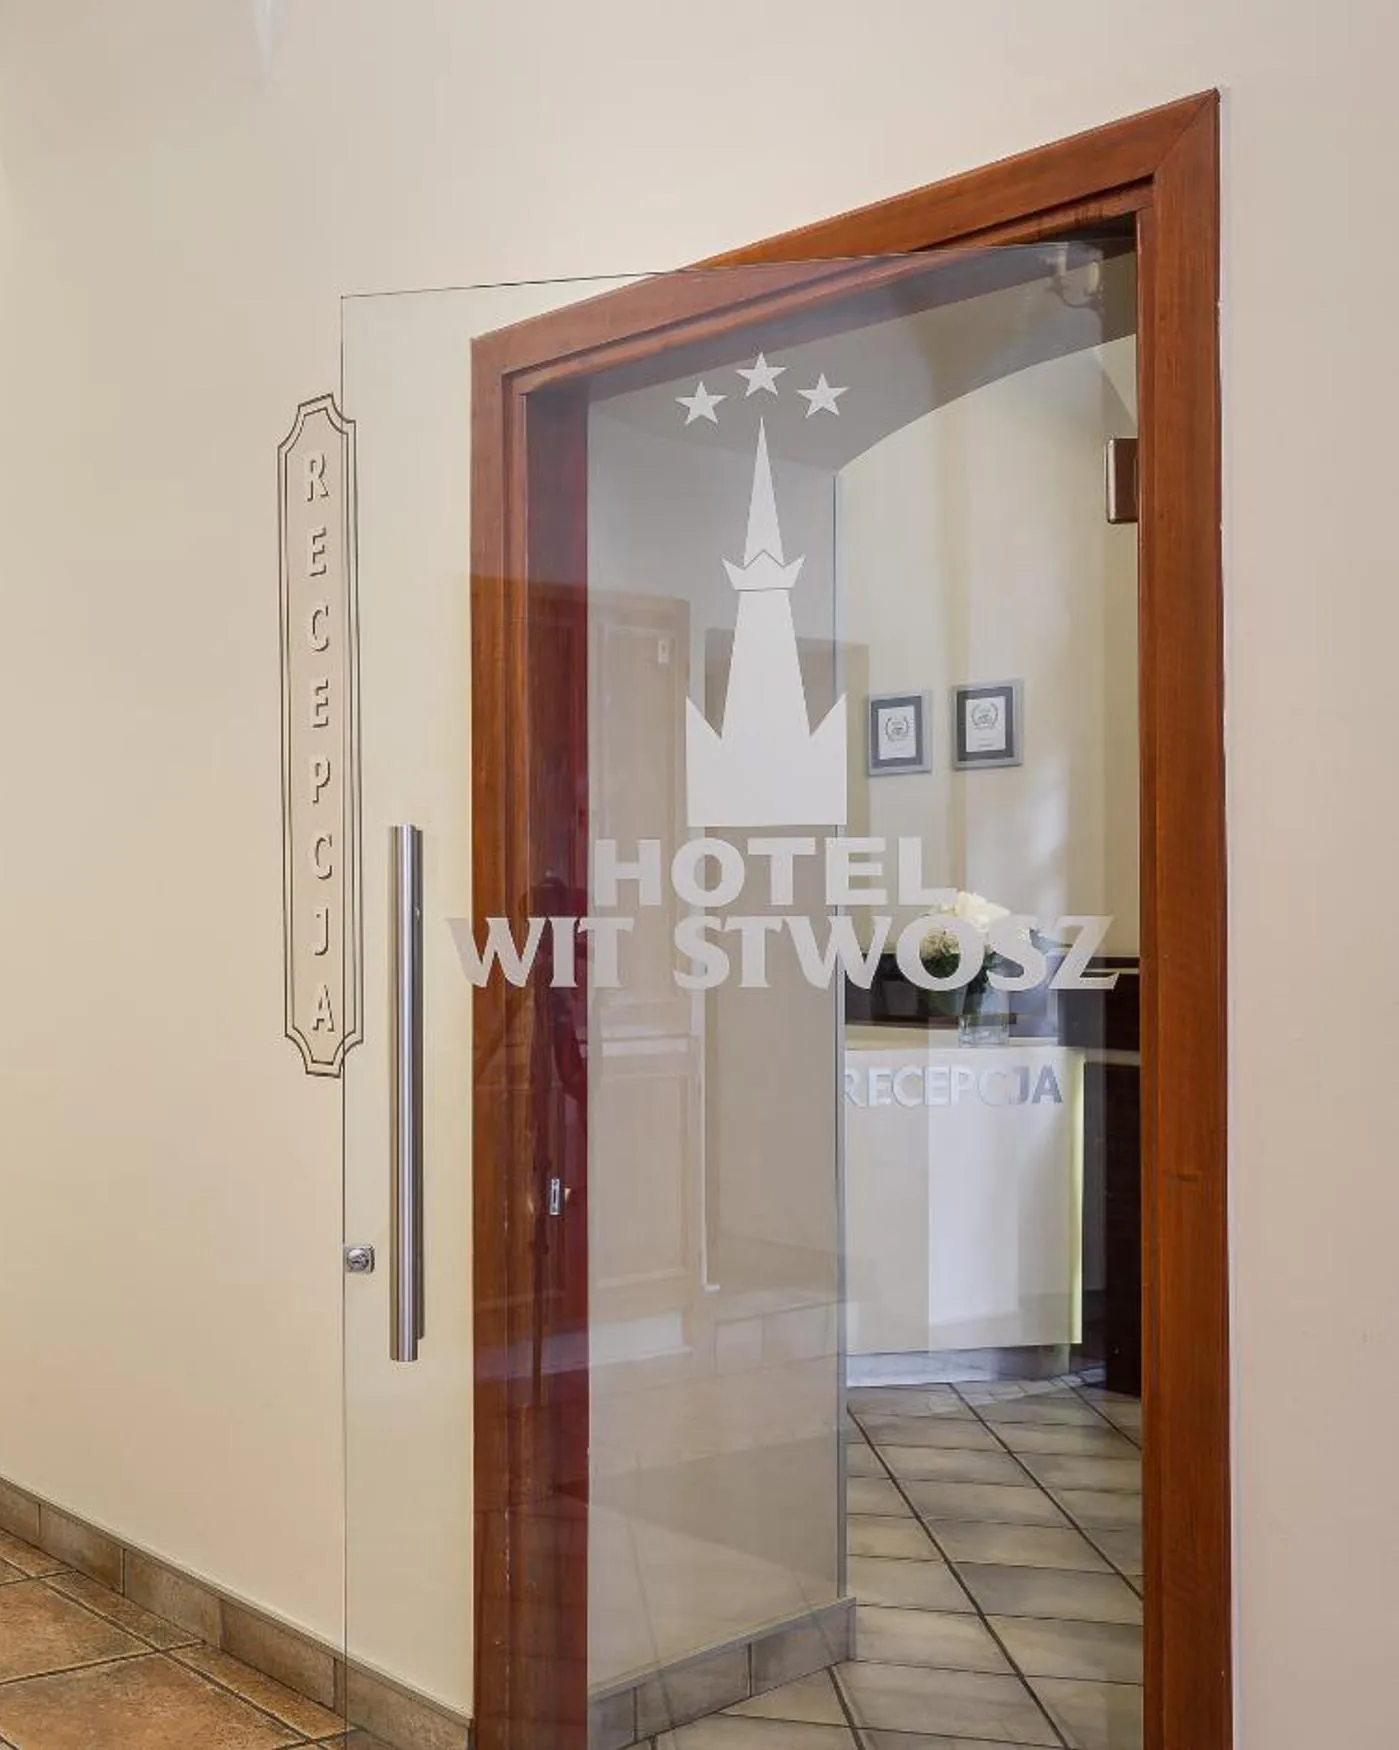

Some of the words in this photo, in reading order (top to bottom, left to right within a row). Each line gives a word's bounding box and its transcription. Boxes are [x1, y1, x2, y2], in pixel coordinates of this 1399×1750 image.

[306, 452, 336, 1033] RECEPCJA
[595, 836, 958, 908] HOTEL
[446, 916, 635, 989] WIT
[672, 914, 1120, 991] STWOSZ
[843, 1064, 1063, 1108] RECEPCJA
